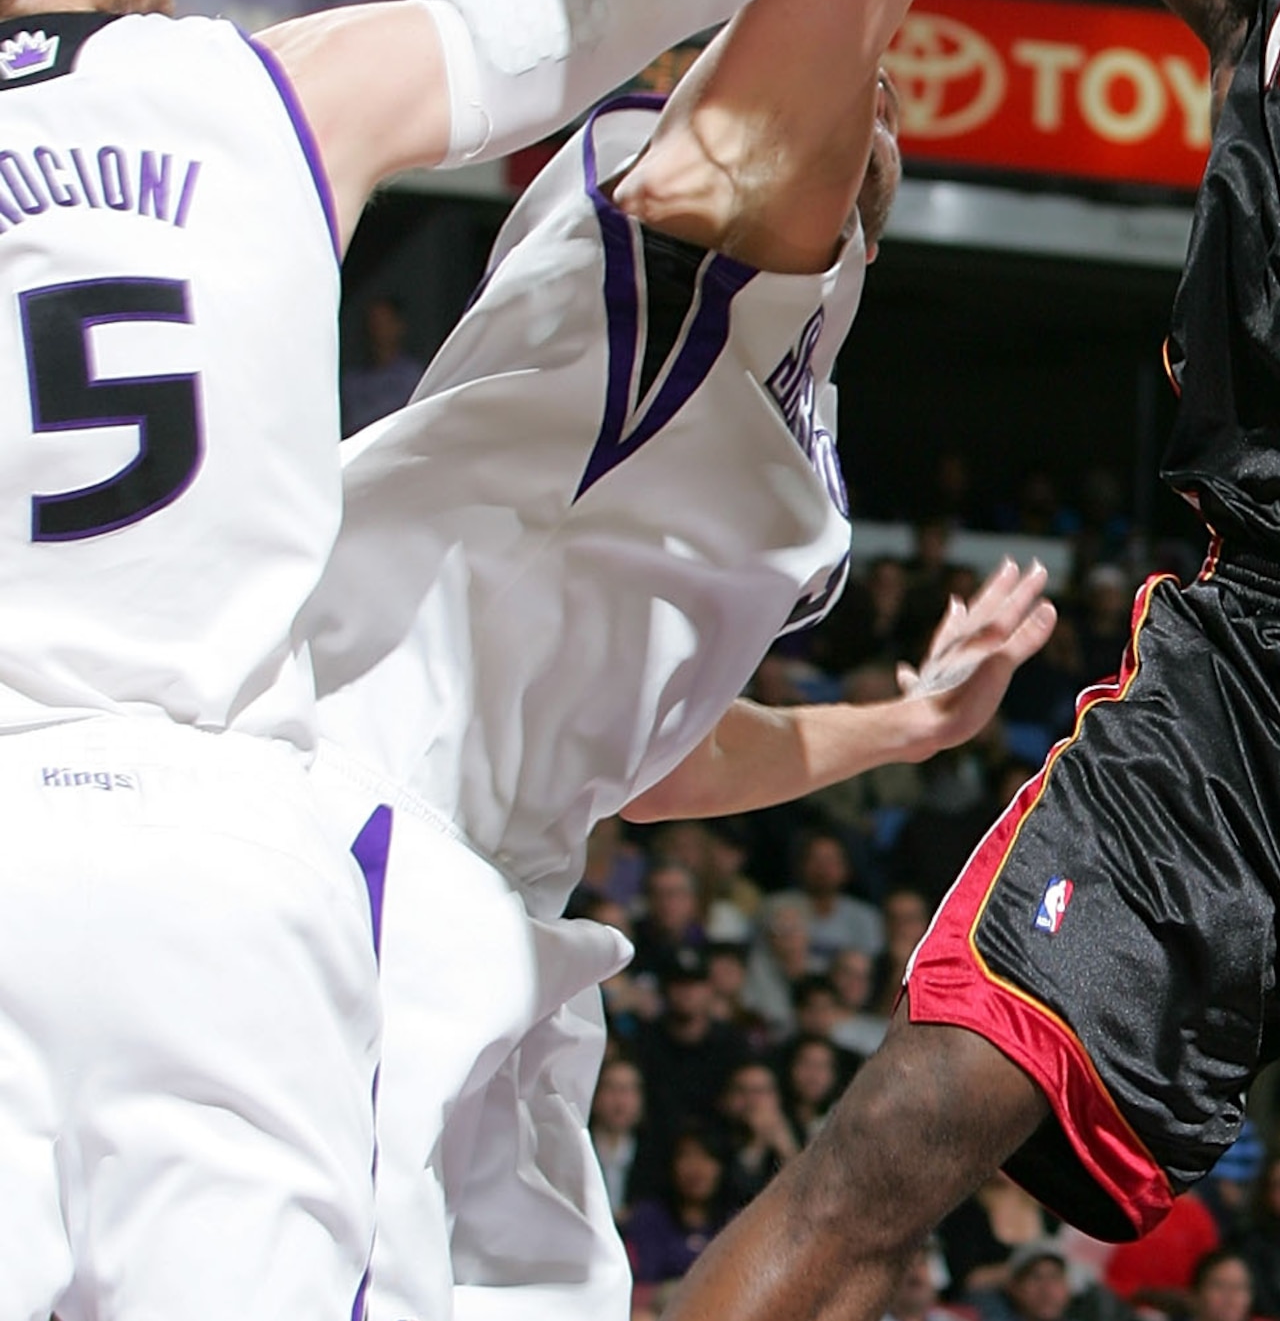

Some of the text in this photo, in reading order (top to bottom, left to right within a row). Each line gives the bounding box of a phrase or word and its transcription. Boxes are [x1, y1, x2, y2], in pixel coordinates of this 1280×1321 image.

[1012, 37, 1213, 150] TOY
[18, 276, 208, 544] 5
[42, 767, 134, 791] Kings
